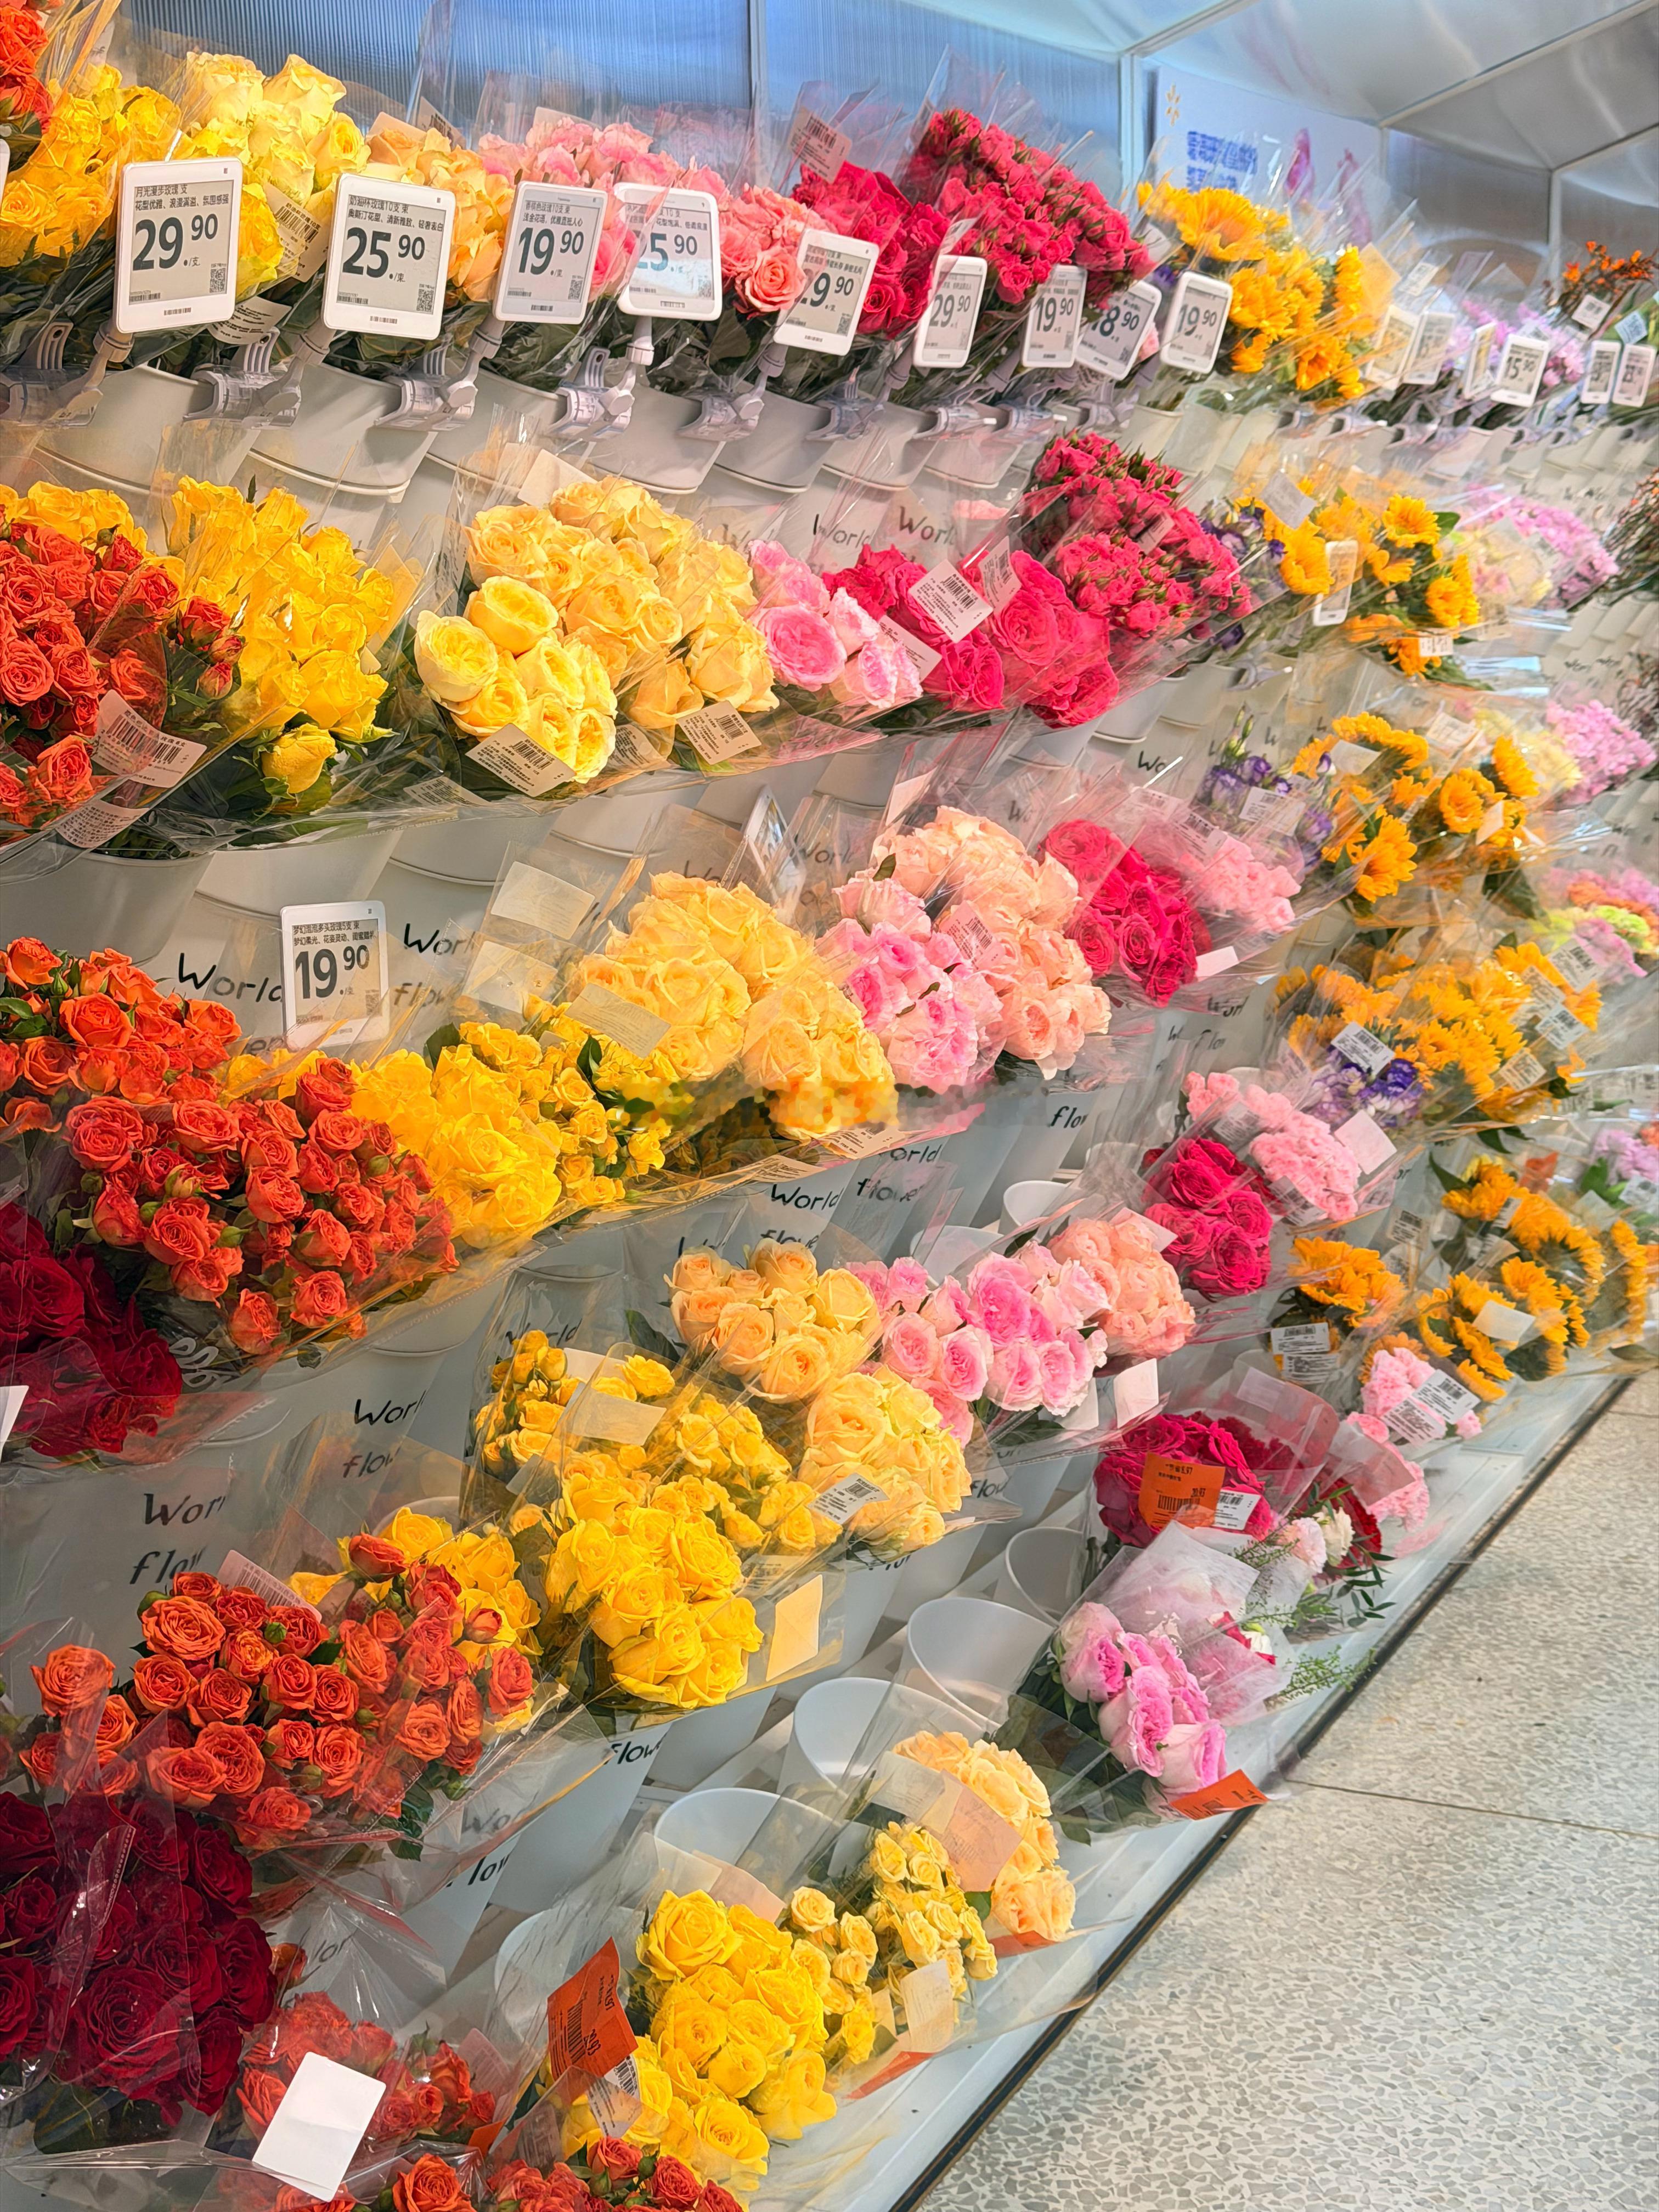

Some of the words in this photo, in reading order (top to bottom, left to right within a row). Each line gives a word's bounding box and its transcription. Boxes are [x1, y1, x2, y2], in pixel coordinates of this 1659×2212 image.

[136, 184, 178, 198] 月光漫步玫瑰
[180, 184, 188, 194] 支
[349, 195, 400, 213] 奶油杯玫瑰10支
[191, 213, 218, 241] 90
[398, 234, 425, 260] 90
[560, 230, 584, 255] 90
[674, 234, 697, 256] 90
[834, 276, 854, 296] 90
[957, 295, 970, 312] 90
[1060, 297, 1074, 316] 90
[1121, 311, 1139, 330] 90
[1201, 310, 1217, 327] 90
[294, 922, 352, 935] 梦幻泡泡多头玫瑰5支
[343, 945, 370, 970] 90
[879, 1144, 943, 1164] orld
[771, 1184, 844, 1210] World
